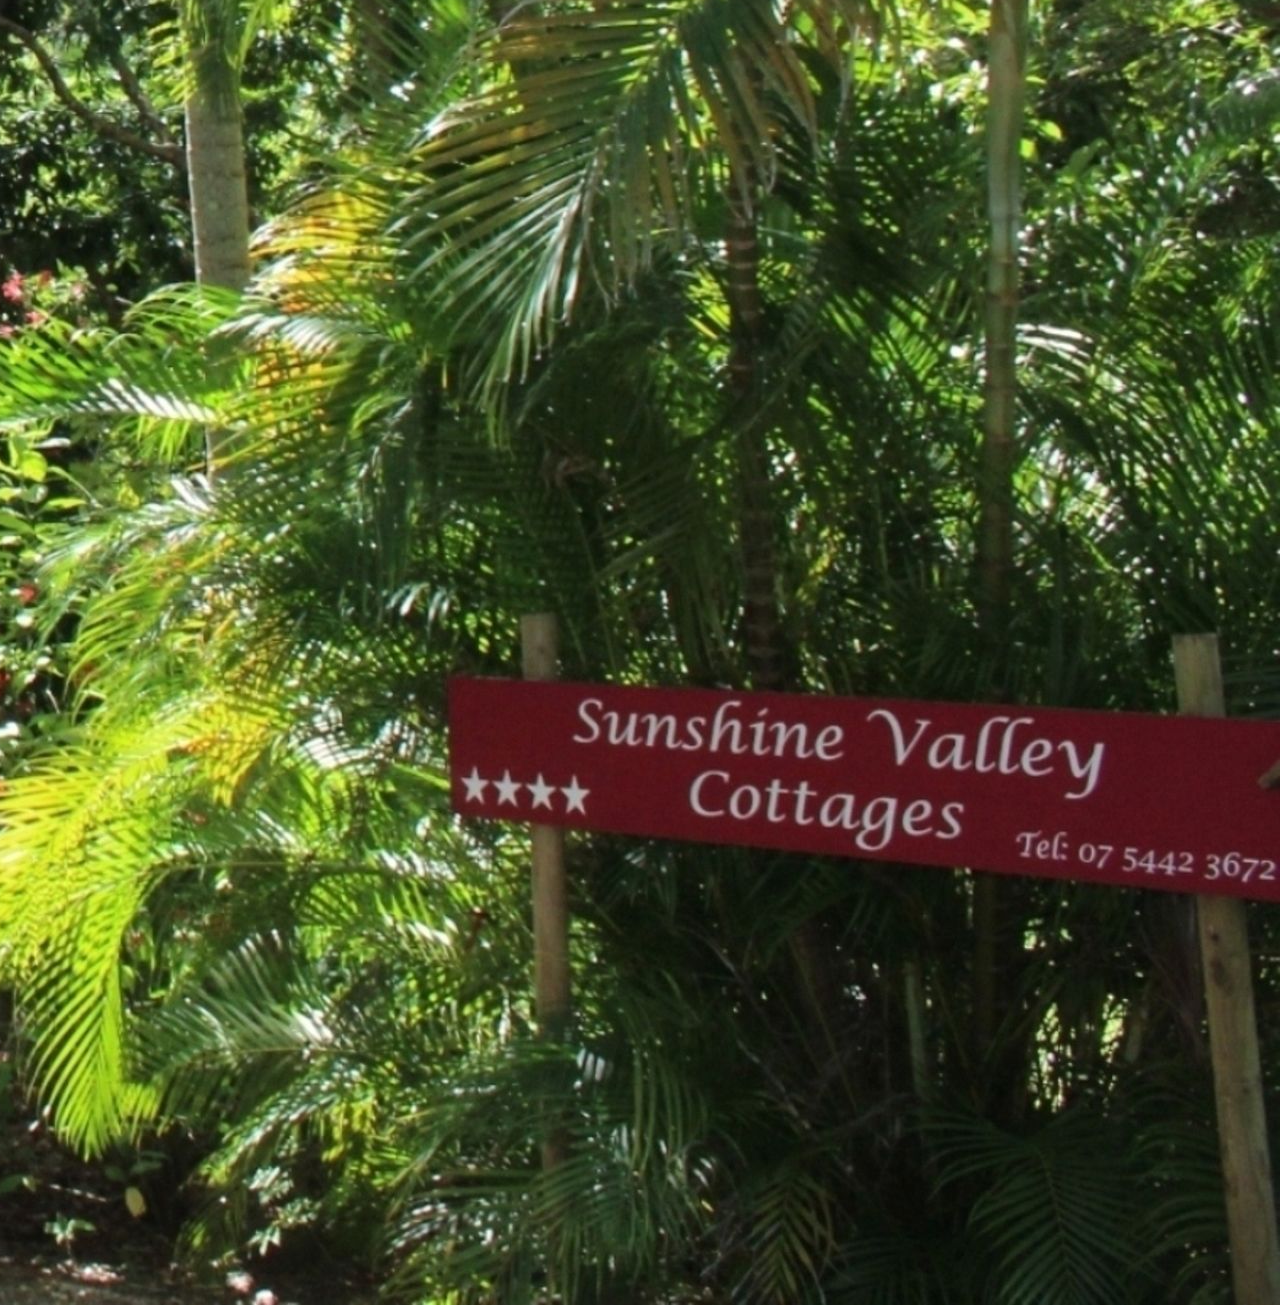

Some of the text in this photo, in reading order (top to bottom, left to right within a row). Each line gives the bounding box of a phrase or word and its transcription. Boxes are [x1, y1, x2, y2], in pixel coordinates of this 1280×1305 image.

[573, 698, 1105, 799] Sunshine Valley
[689, 770, 966, 851] Cottages
[1016, 830, 1276, 883] Tel: 07 5442 3672
